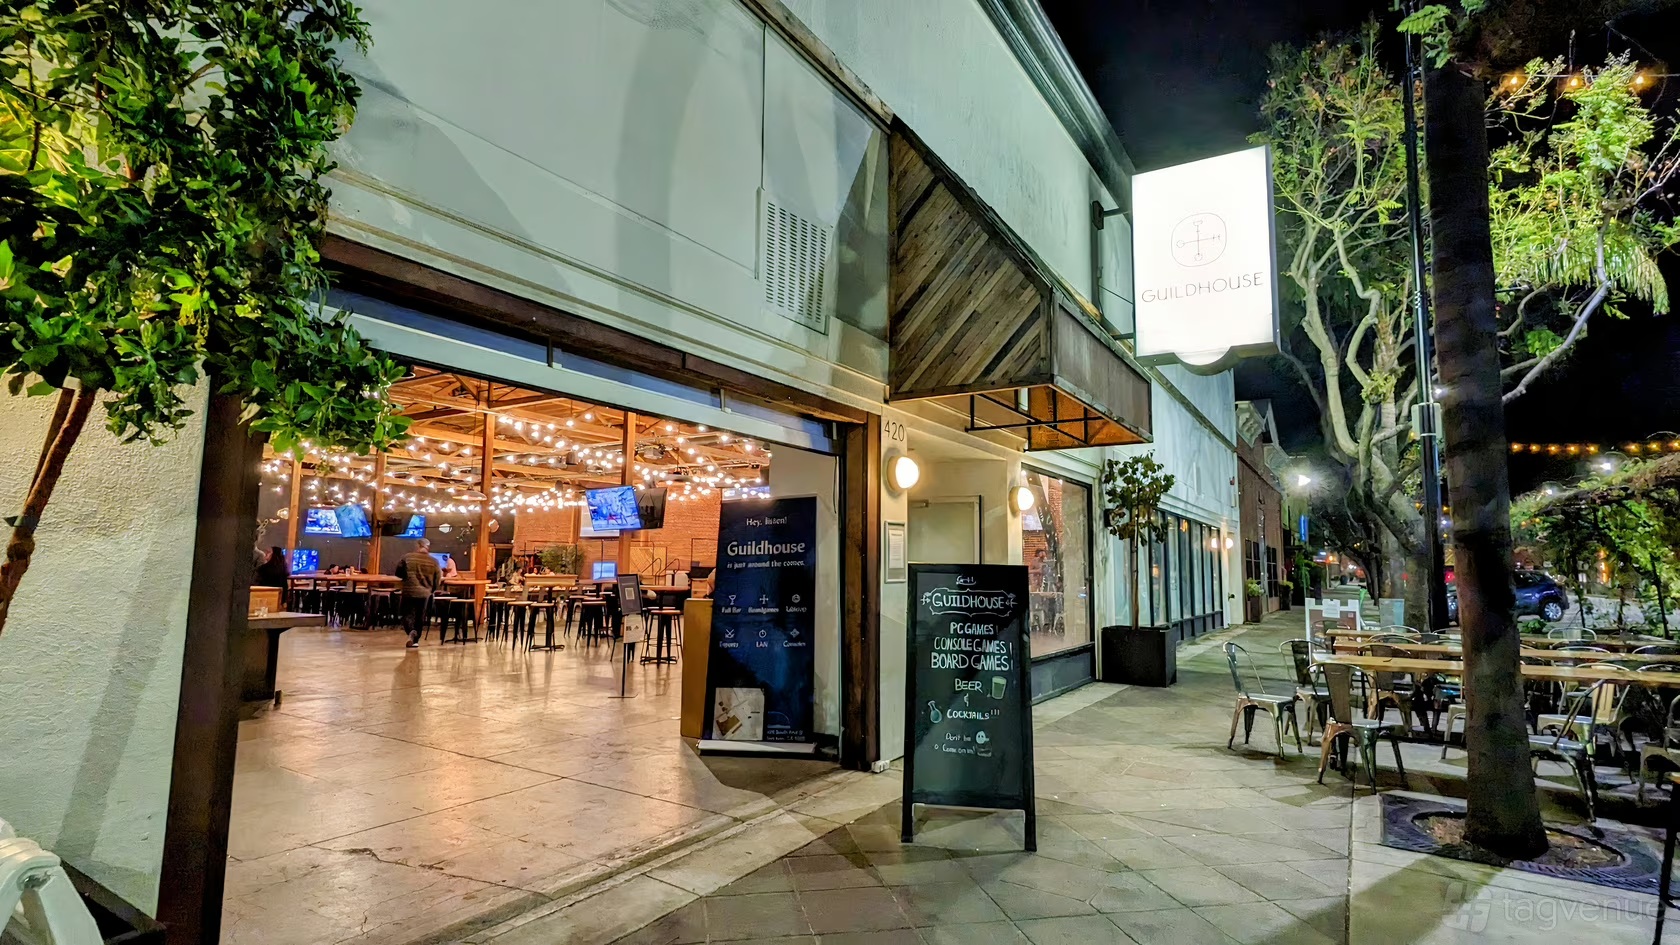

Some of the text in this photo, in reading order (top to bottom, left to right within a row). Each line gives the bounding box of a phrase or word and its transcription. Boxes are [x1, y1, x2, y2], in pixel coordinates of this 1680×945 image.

[1141, 272, 1264, 303] GUILDHOUSE
[884, 420, 905, 442] 420
[727, 540, 806, 557] Guildhouse
[932, 592, 1005, 610] GUILDHOUSE
[949, 621, 964, 635] PC
[934, 636, 973, 651] CONSOLE
[931, 652, 969, 669] BOARD
[954, 678, 983, 694] BEER
